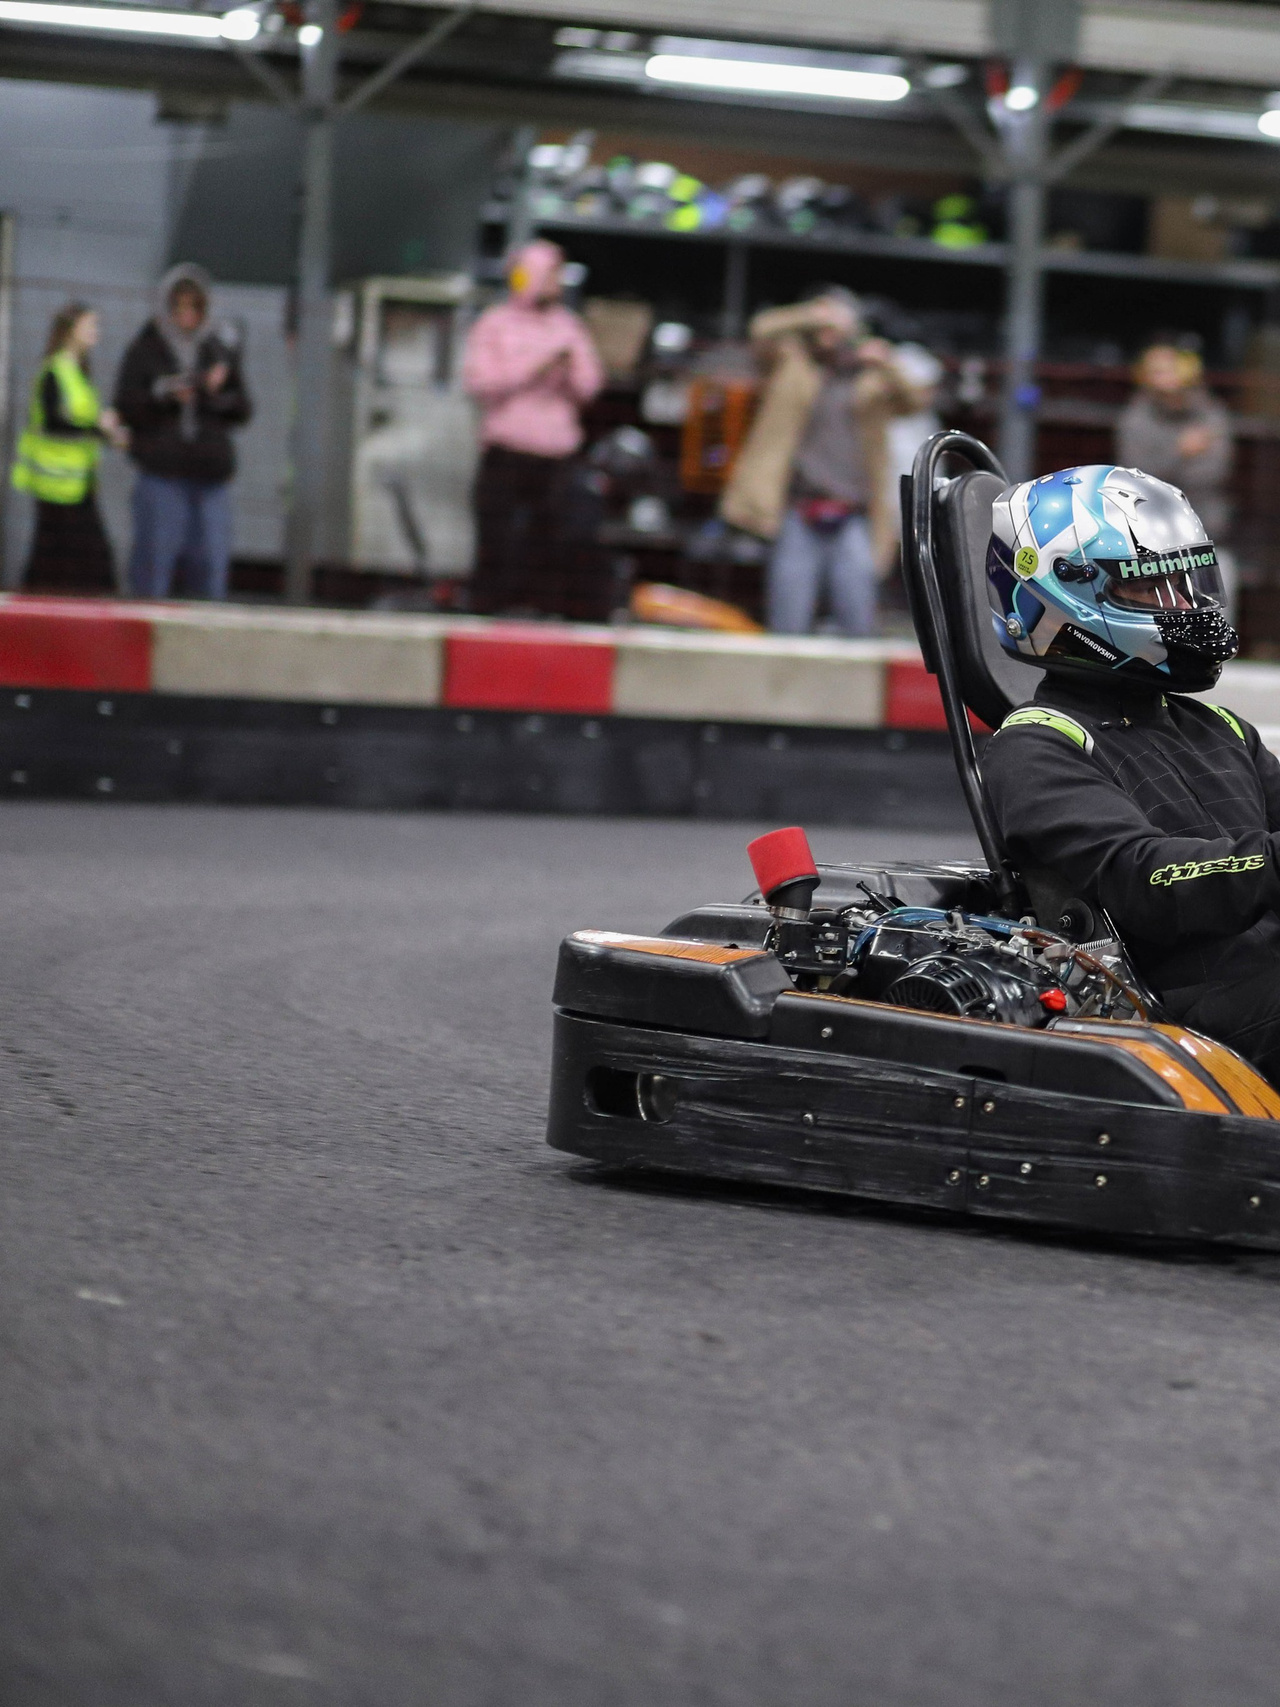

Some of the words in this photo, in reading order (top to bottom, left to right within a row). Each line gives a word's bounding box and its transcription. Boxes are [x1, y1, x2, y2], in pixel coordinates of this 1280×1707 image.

[1119, 551, 1215, 579] Hammer
[1073, 629, 1118, 661] YAVOROVSKIY
[1149, 854, 1265, 886] alpinestars
